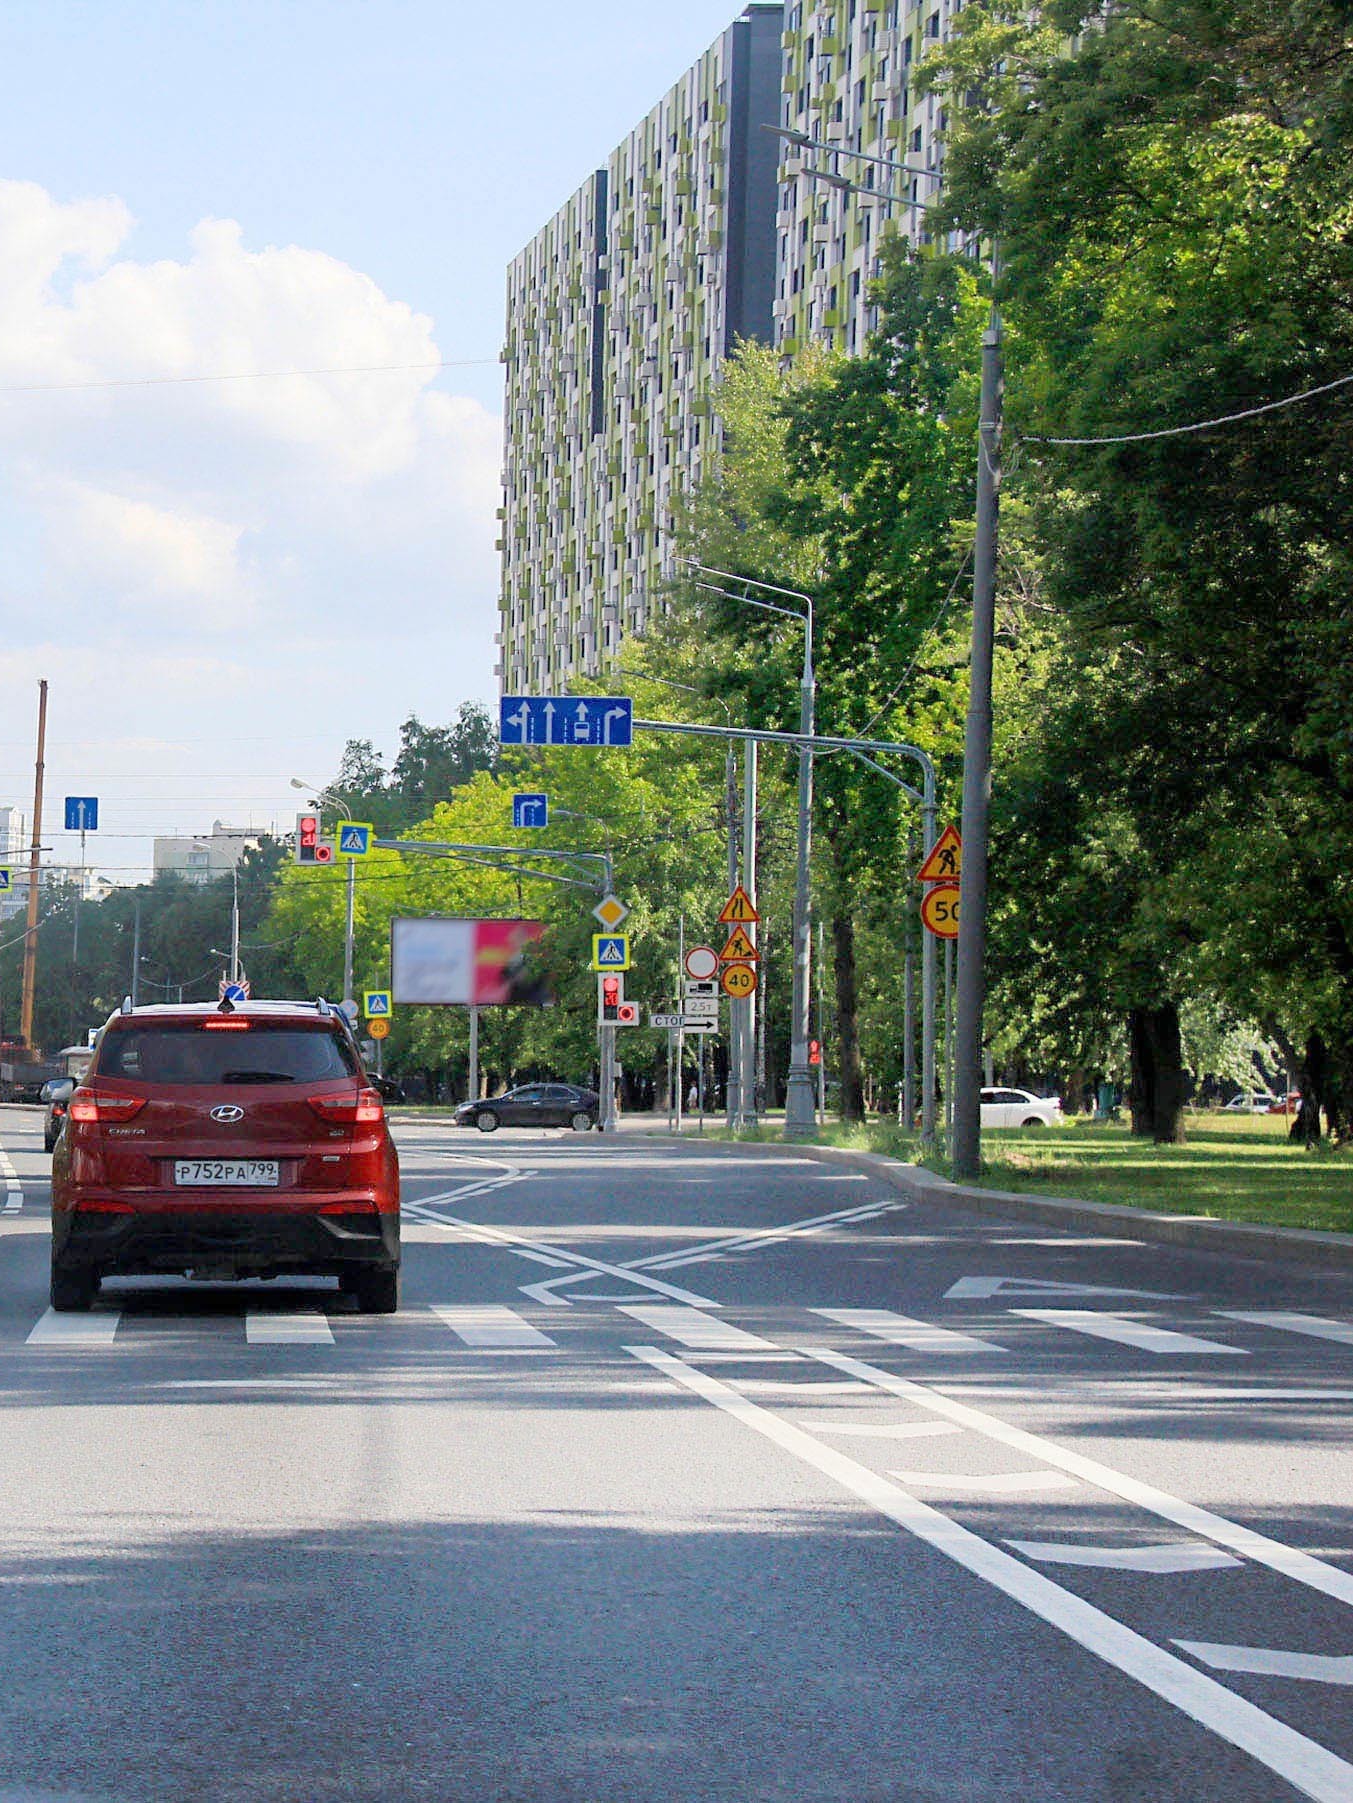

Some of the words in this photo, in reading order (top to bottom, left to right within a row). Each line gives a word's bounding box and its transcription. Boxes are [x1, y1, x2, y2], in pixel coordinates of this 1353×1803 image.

[728, 974, 750, 987] 40
[372, 1023, 385, 1033] 40
[249, 1163, 274, 1175] 799
